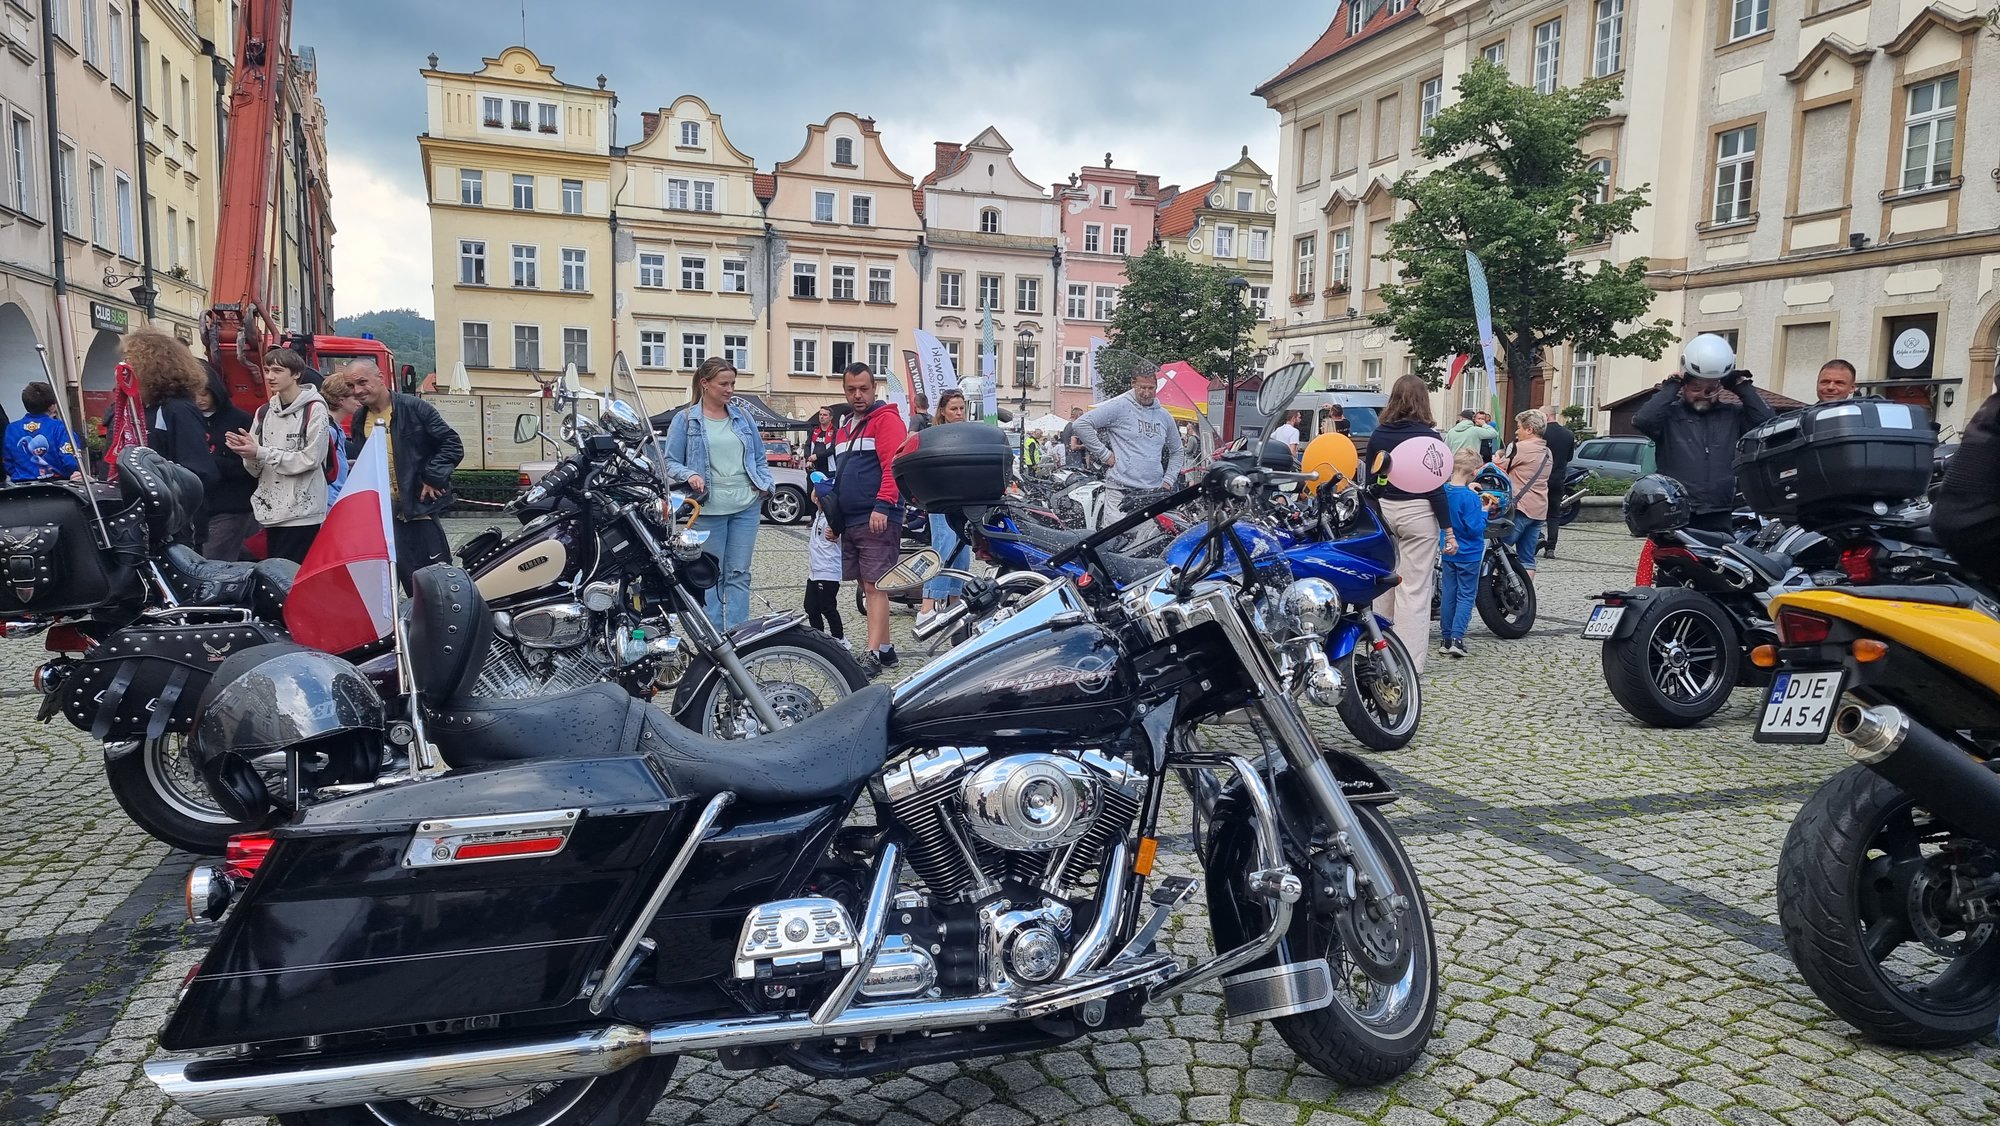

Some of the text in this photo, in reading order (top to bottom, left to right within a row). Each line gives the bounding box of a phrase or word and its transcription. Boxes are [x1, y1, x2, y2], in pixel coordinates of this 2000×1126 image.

[95, 304, 111, 321] CLUB
[520, 556, 547, 571] YAMAHA
[1303, 555, 1374, 581] Bandit S
[1600, 609, 1615, 620] DJ
[1588, 622, 1616, 633] 6006
[1772, 691, 1783, 702] PL
[1786, 678, 1828, 699] DJE
[1767, 706, 1826, 727] JA54
